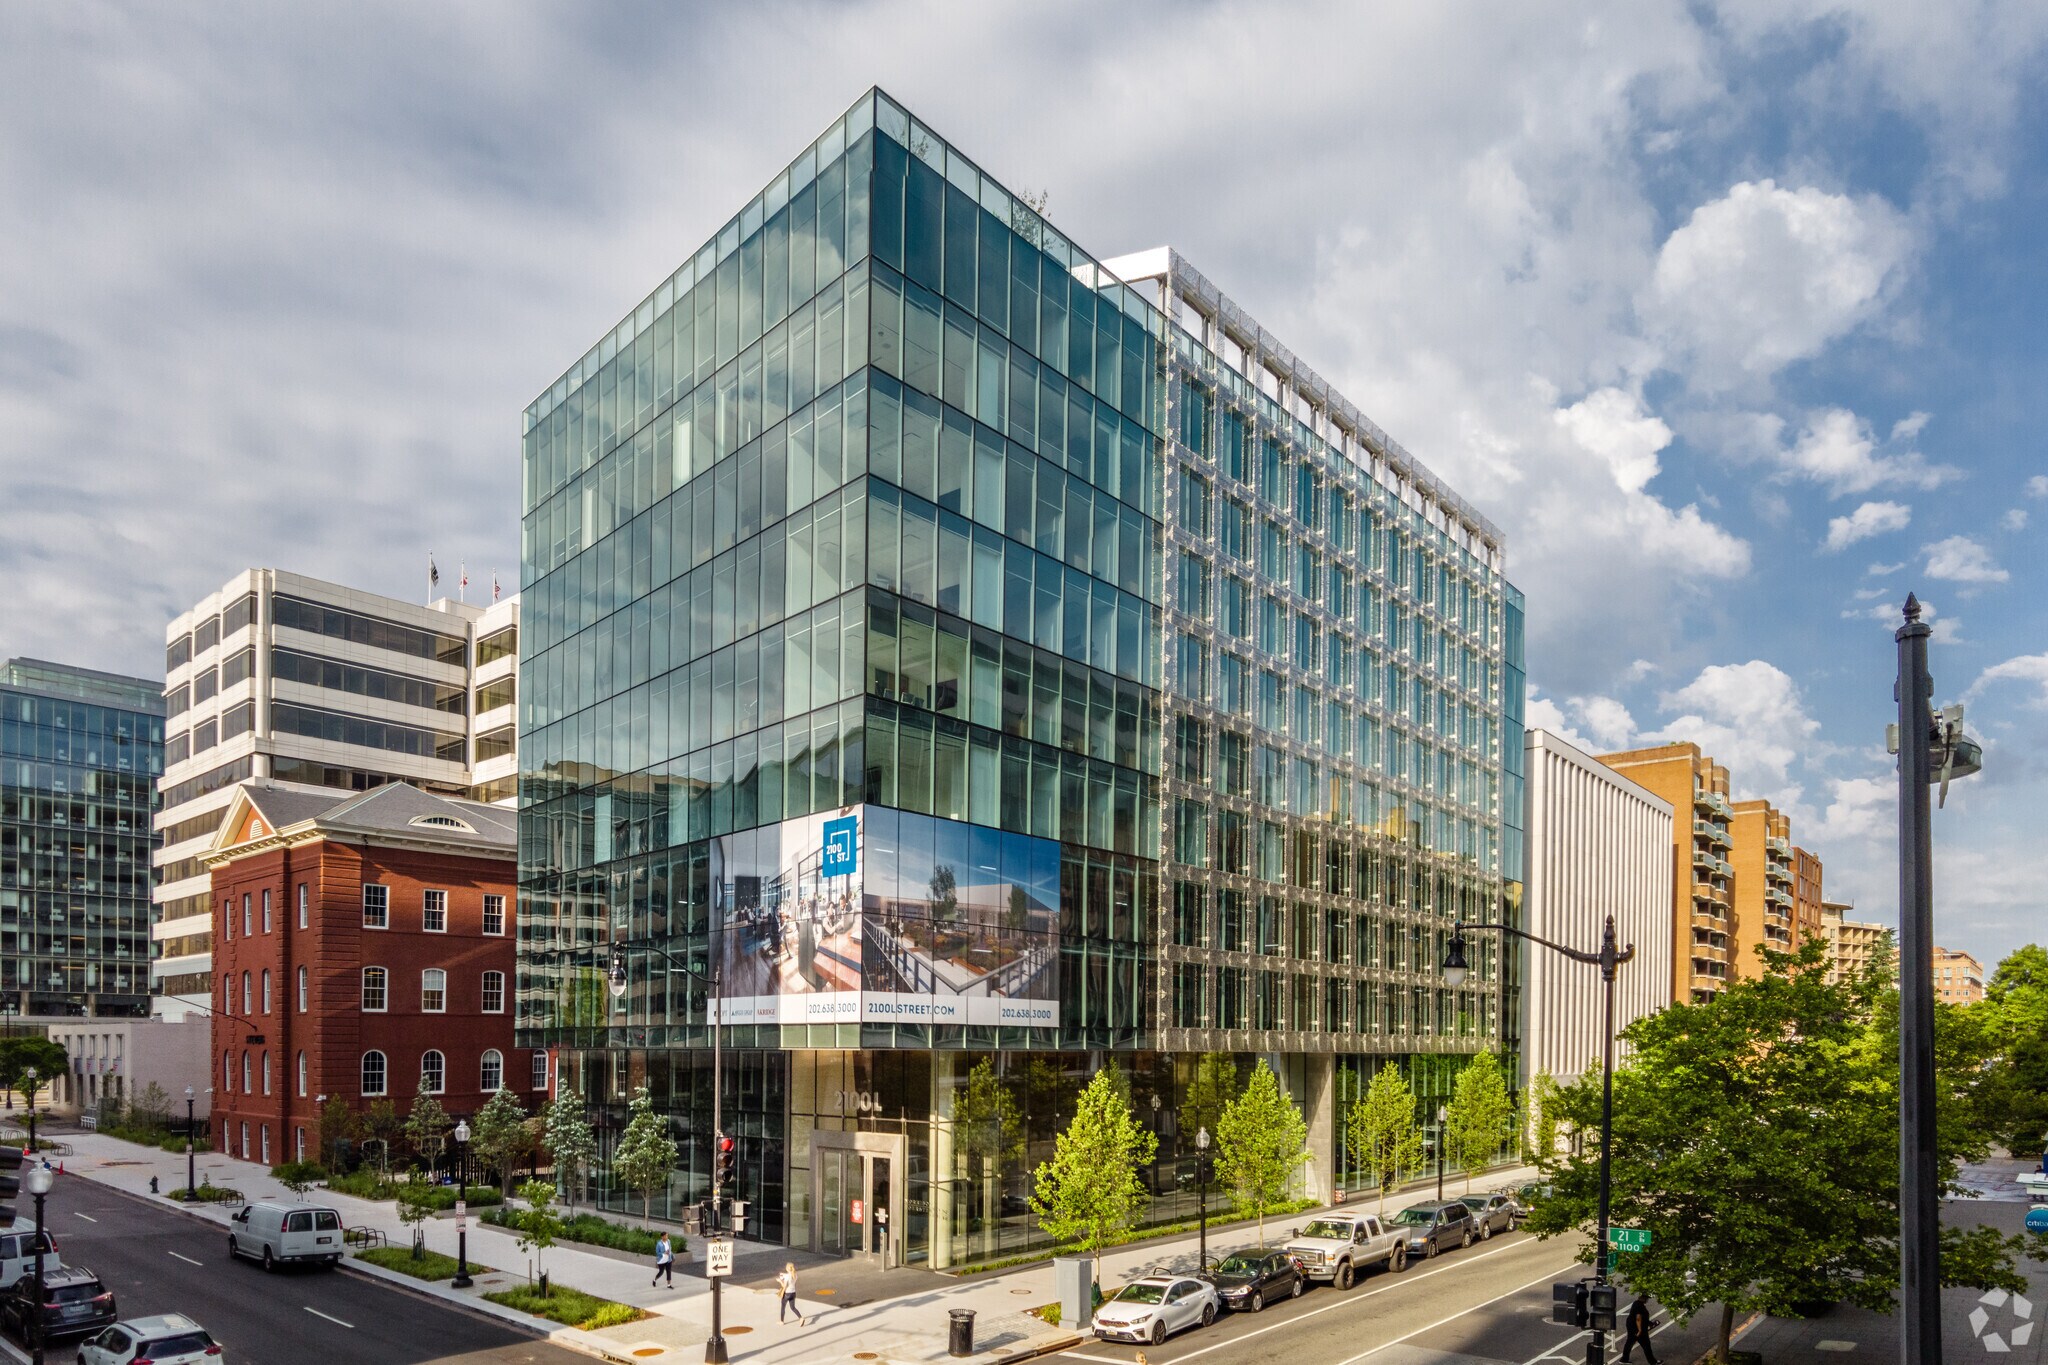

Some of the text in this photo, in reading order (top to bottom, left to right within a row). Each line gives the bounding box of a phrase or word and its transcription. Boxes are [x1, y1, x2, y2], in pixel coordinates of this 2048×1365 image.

[826, 843, 842, 854] 2100
[830, 852, 846, 864] L ST
[808, 1003, 857, 1014] 202.638.3000
[868, 1003, 955, 1015] 2100LSTREET.COM
[1001, 1008, 1051, 1019] 202.638.3000
[834, 1090, 882, 1112] 2100 L
[1618, 1231, 1629, 1242] 21
[712, 1245, 729, 1253] ONE
[1620, 1243, 1640, 1251] 1100
[712, 1254, 728, 1262] WAY
